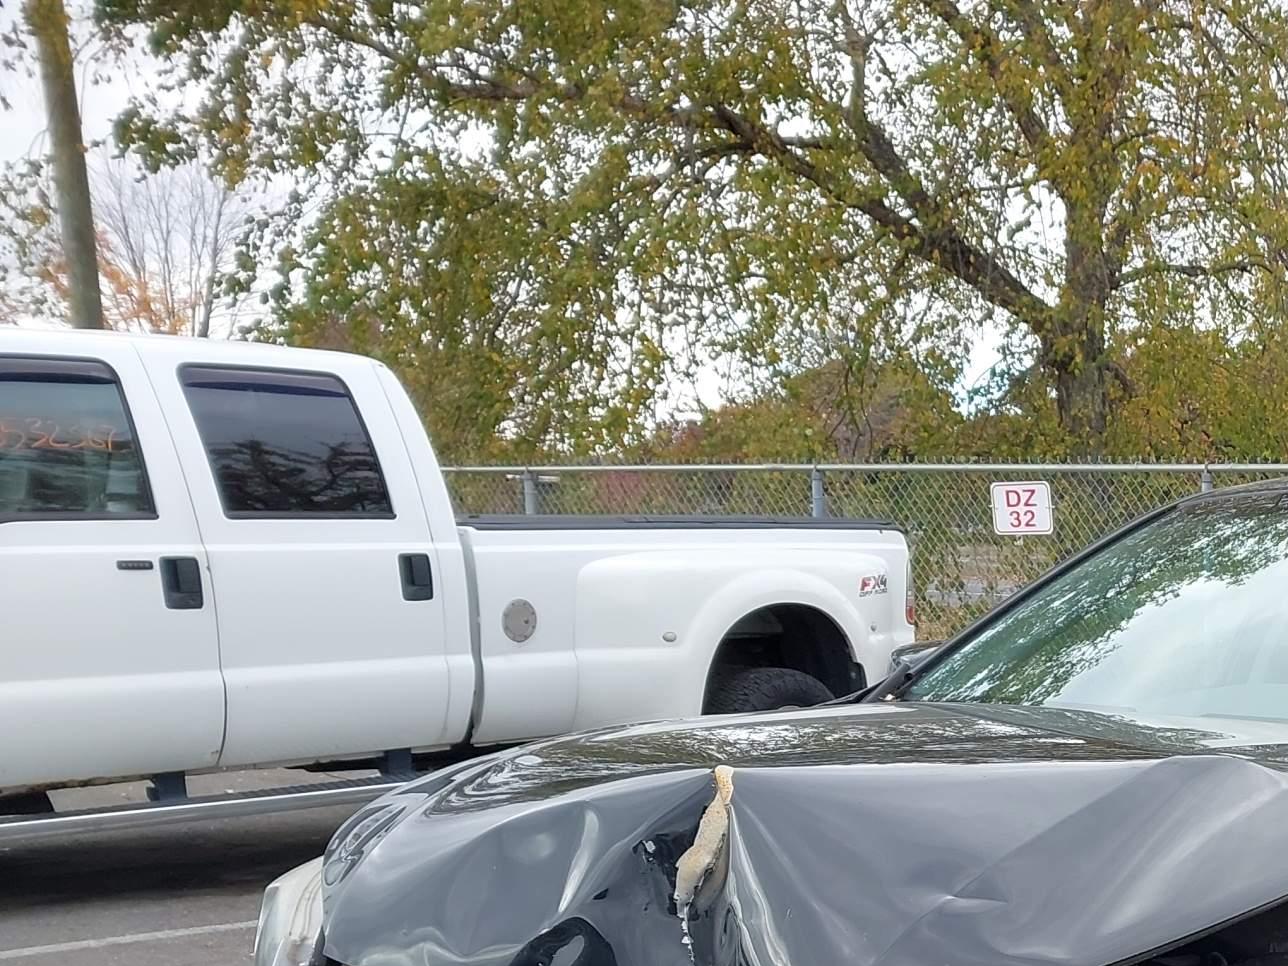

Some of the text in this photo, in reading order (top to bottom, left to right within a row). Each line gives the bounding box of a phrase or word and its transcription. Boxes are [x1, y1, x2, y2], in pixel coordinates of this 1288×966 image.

[1005, 489, 1037, 507] DZ
[1009, 510, 1036, 528] 32
[860, 574, 887, 591] FX4
